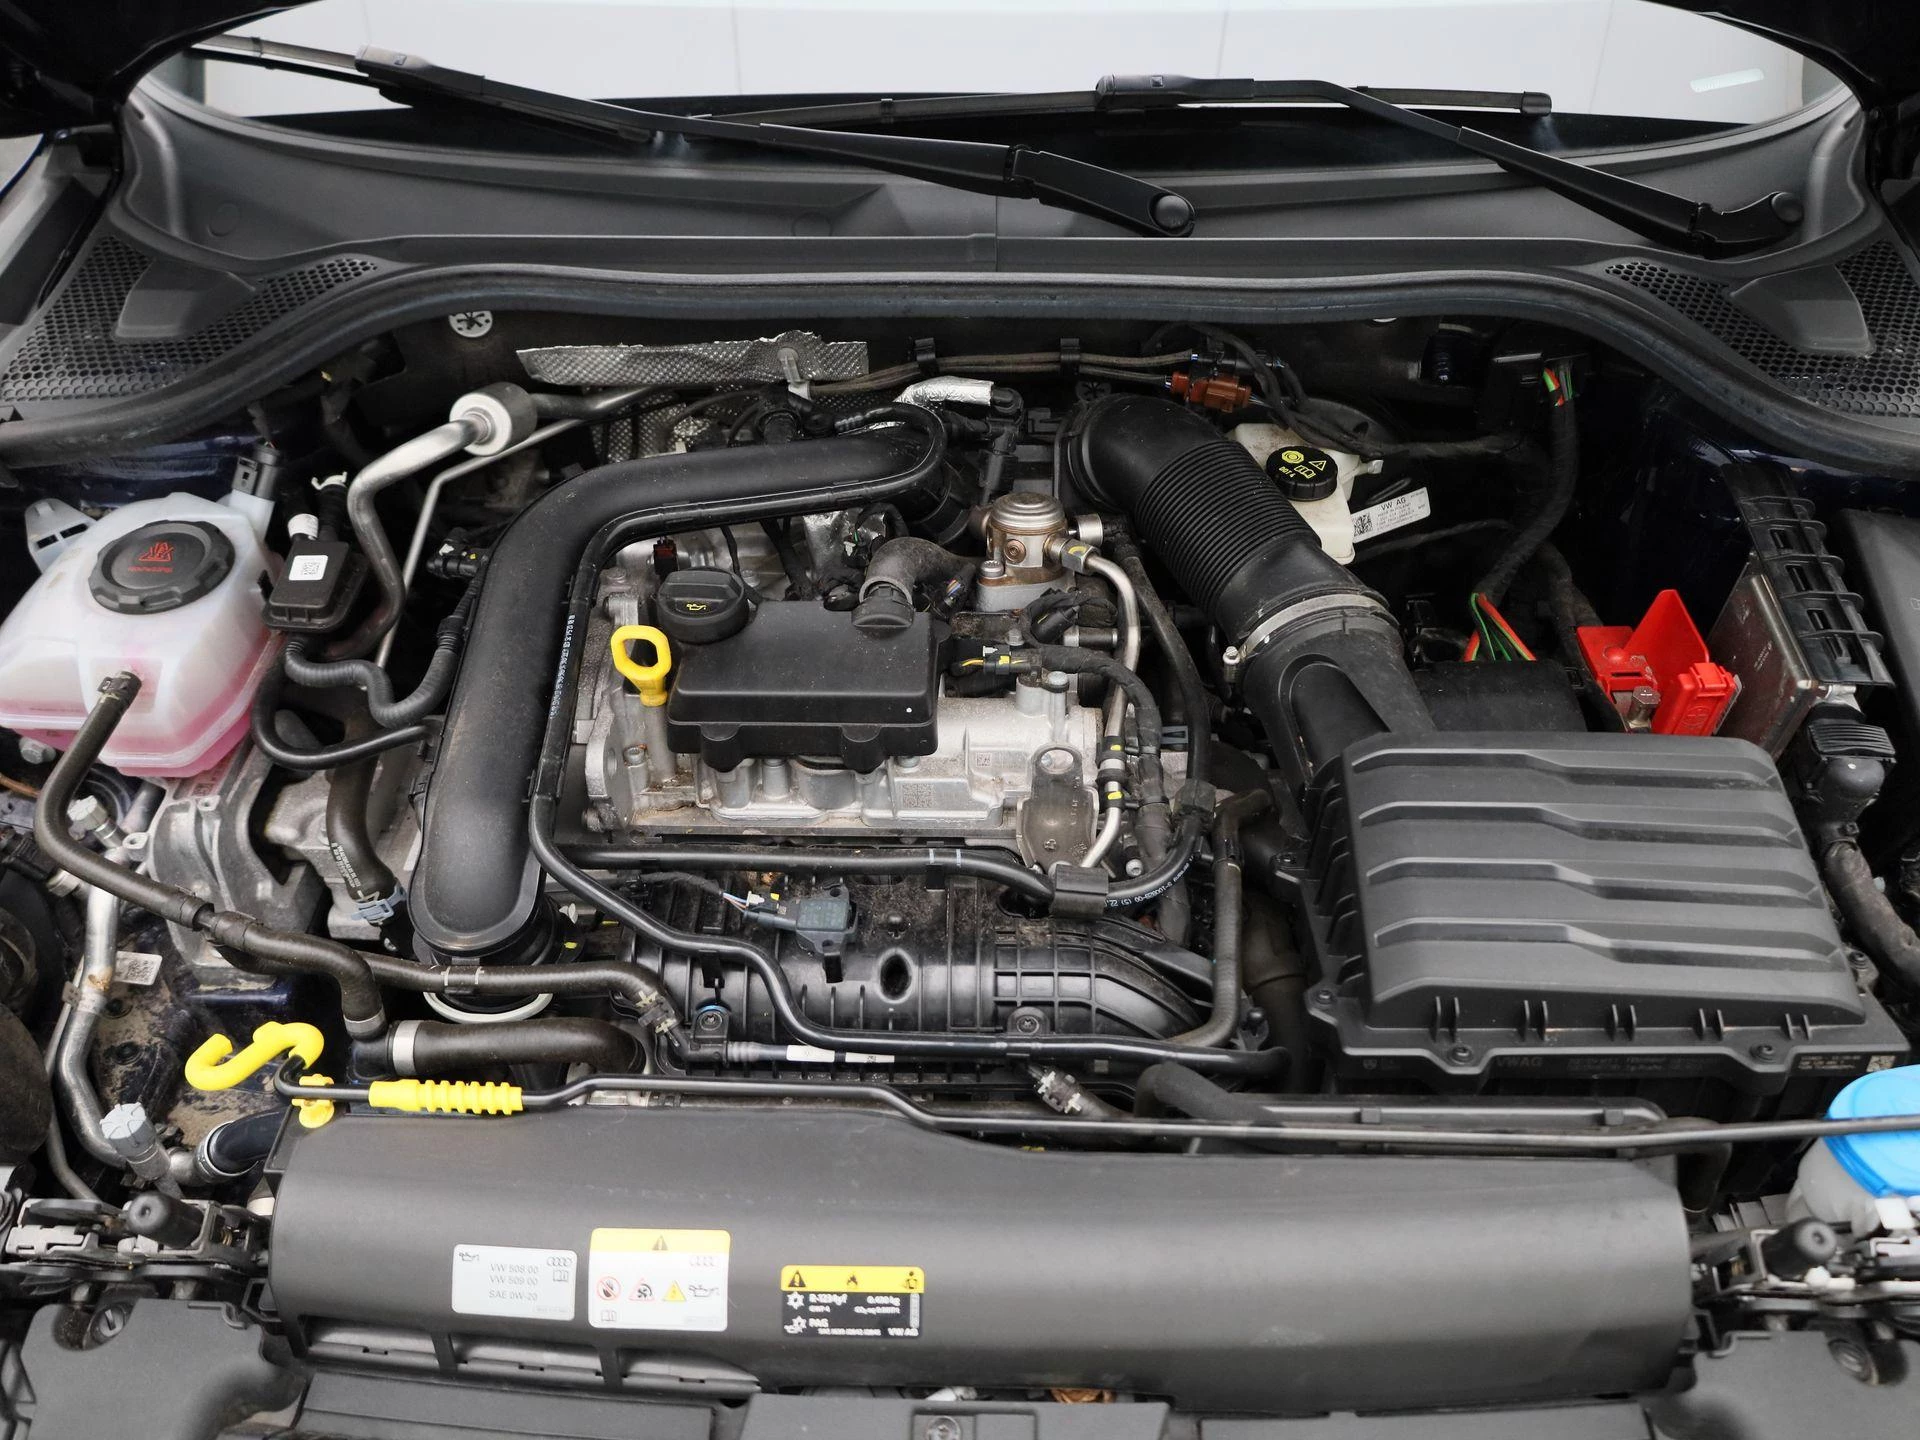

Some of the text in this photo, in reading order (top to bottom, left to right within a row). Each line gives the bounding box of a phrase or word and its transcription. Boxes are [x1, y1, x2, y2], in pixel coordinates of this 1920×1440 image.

[1380, 497, 1406, 511] VW AG
[490, 1264, 506, 1272] VW
[527, 1266, 539, 1274] 00
[489, 1276, 506, 1284] VW
[527, 1278, 538, 1286] 00
[489, 1290, 507, 1299] SAE
[887, 1327, 904, 1336] VW
[904, 1328, 919, 1336] AG
